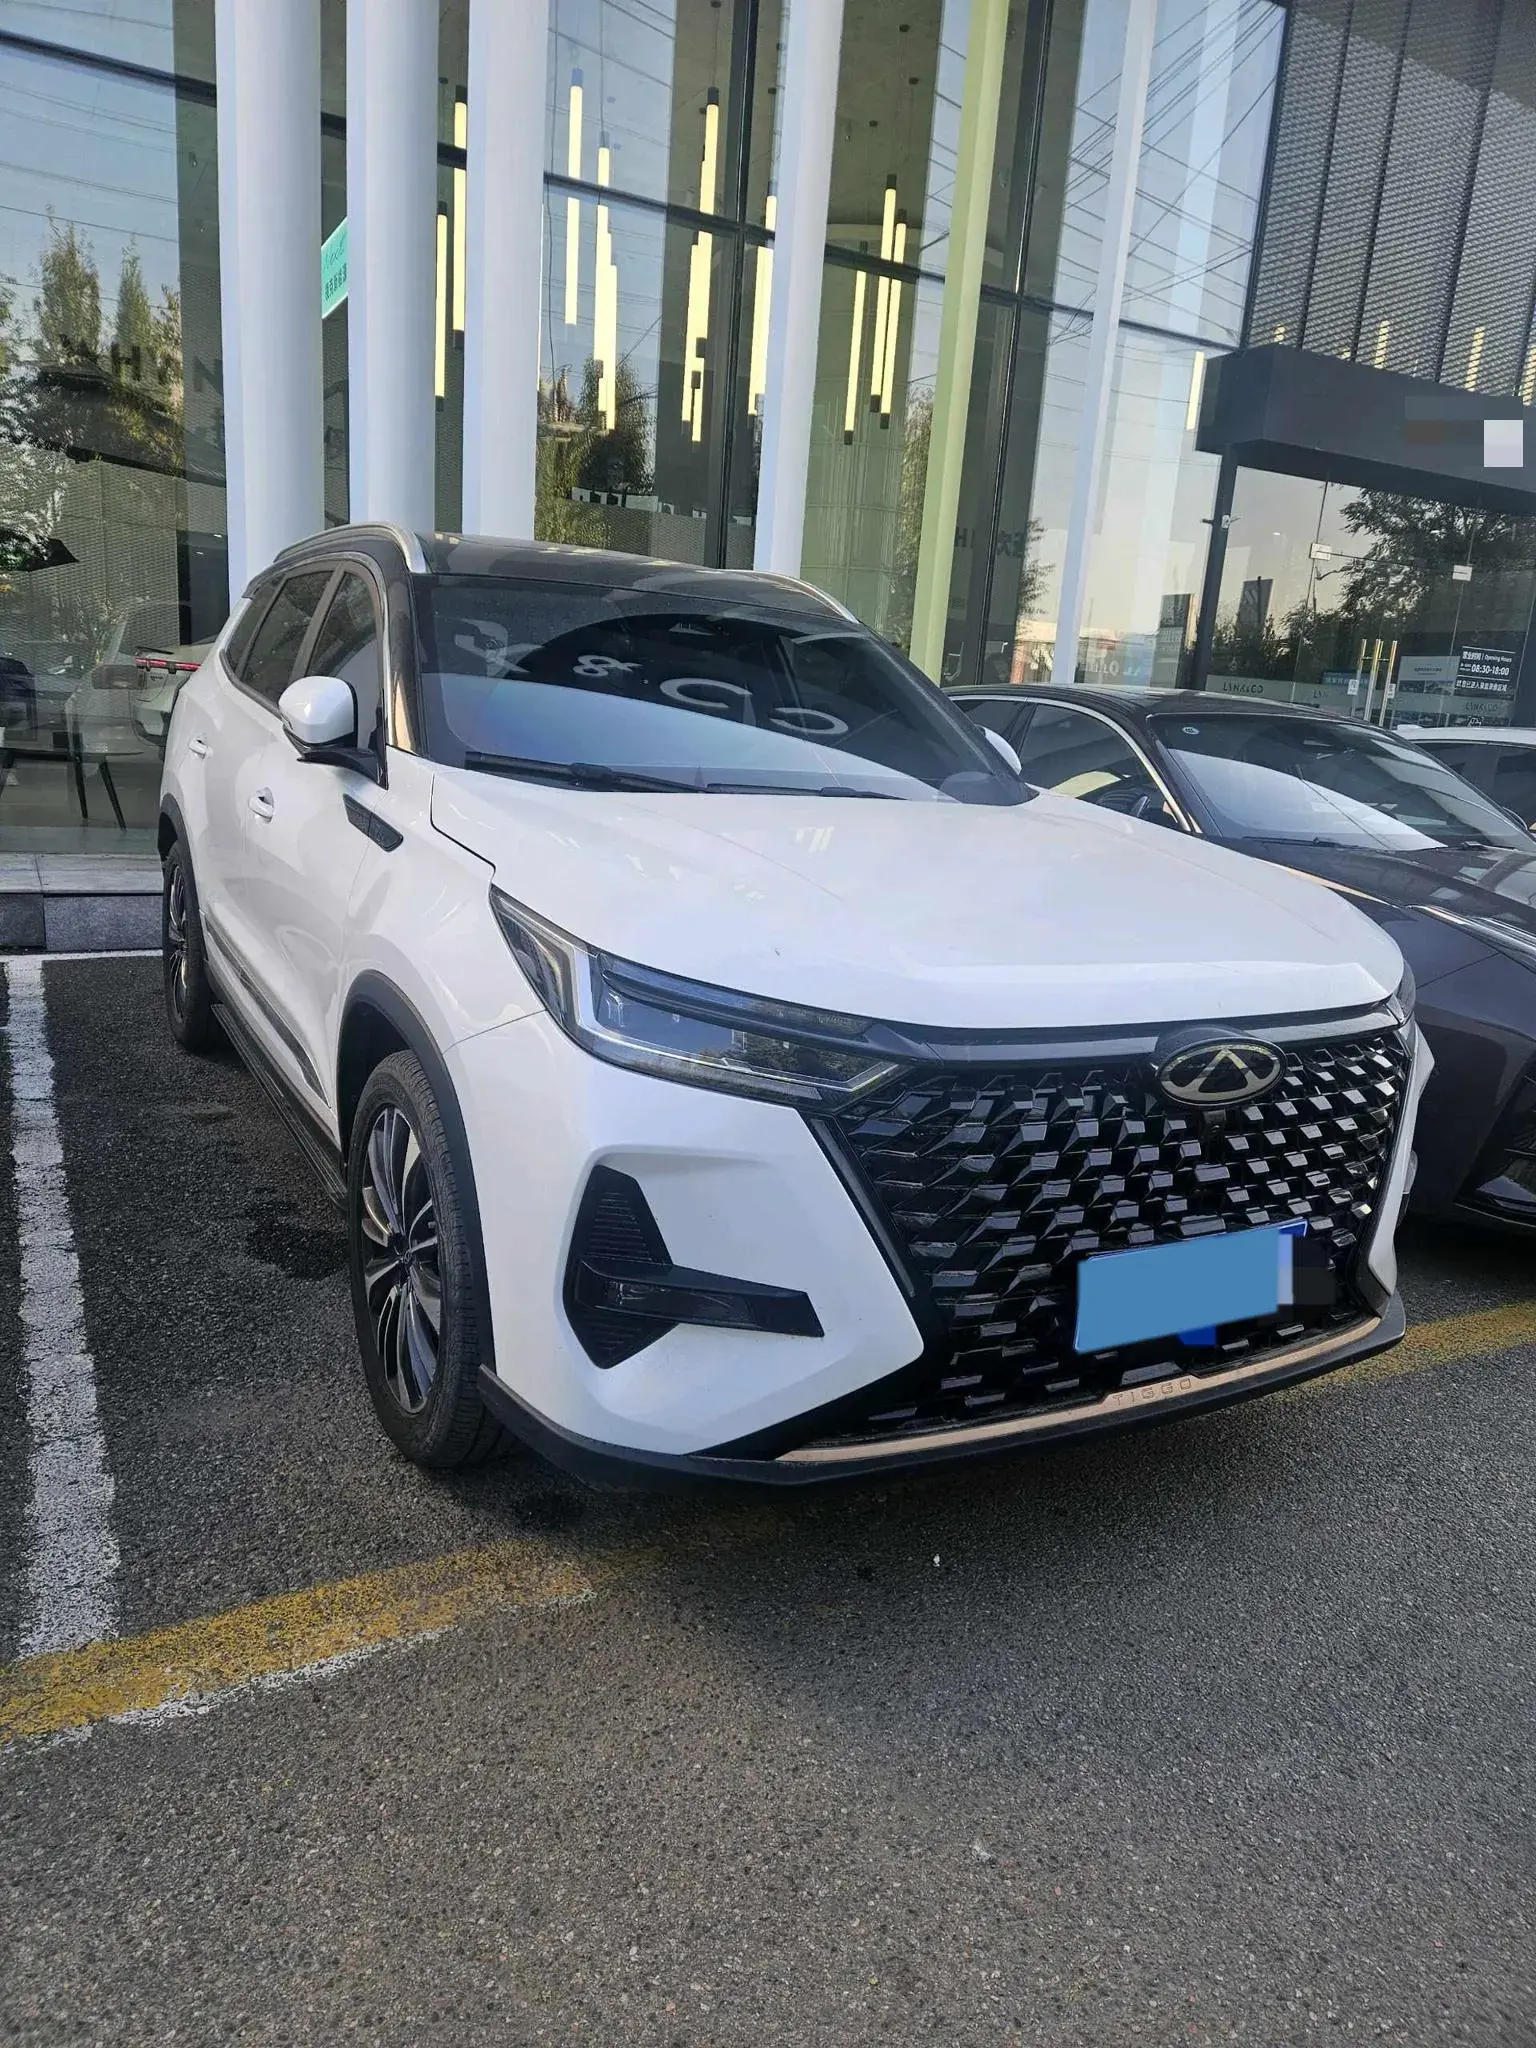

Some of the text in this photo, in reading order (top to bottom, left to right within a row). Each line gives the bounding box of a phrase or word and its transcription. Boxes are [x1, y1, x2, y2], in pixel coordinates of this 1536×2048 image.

[1462, 651, 1482, 661] 营业时间
[1471, 664, 1510, 676] 08:30-18:00
[1112, 1378, 1191, 1406] TIGGO
